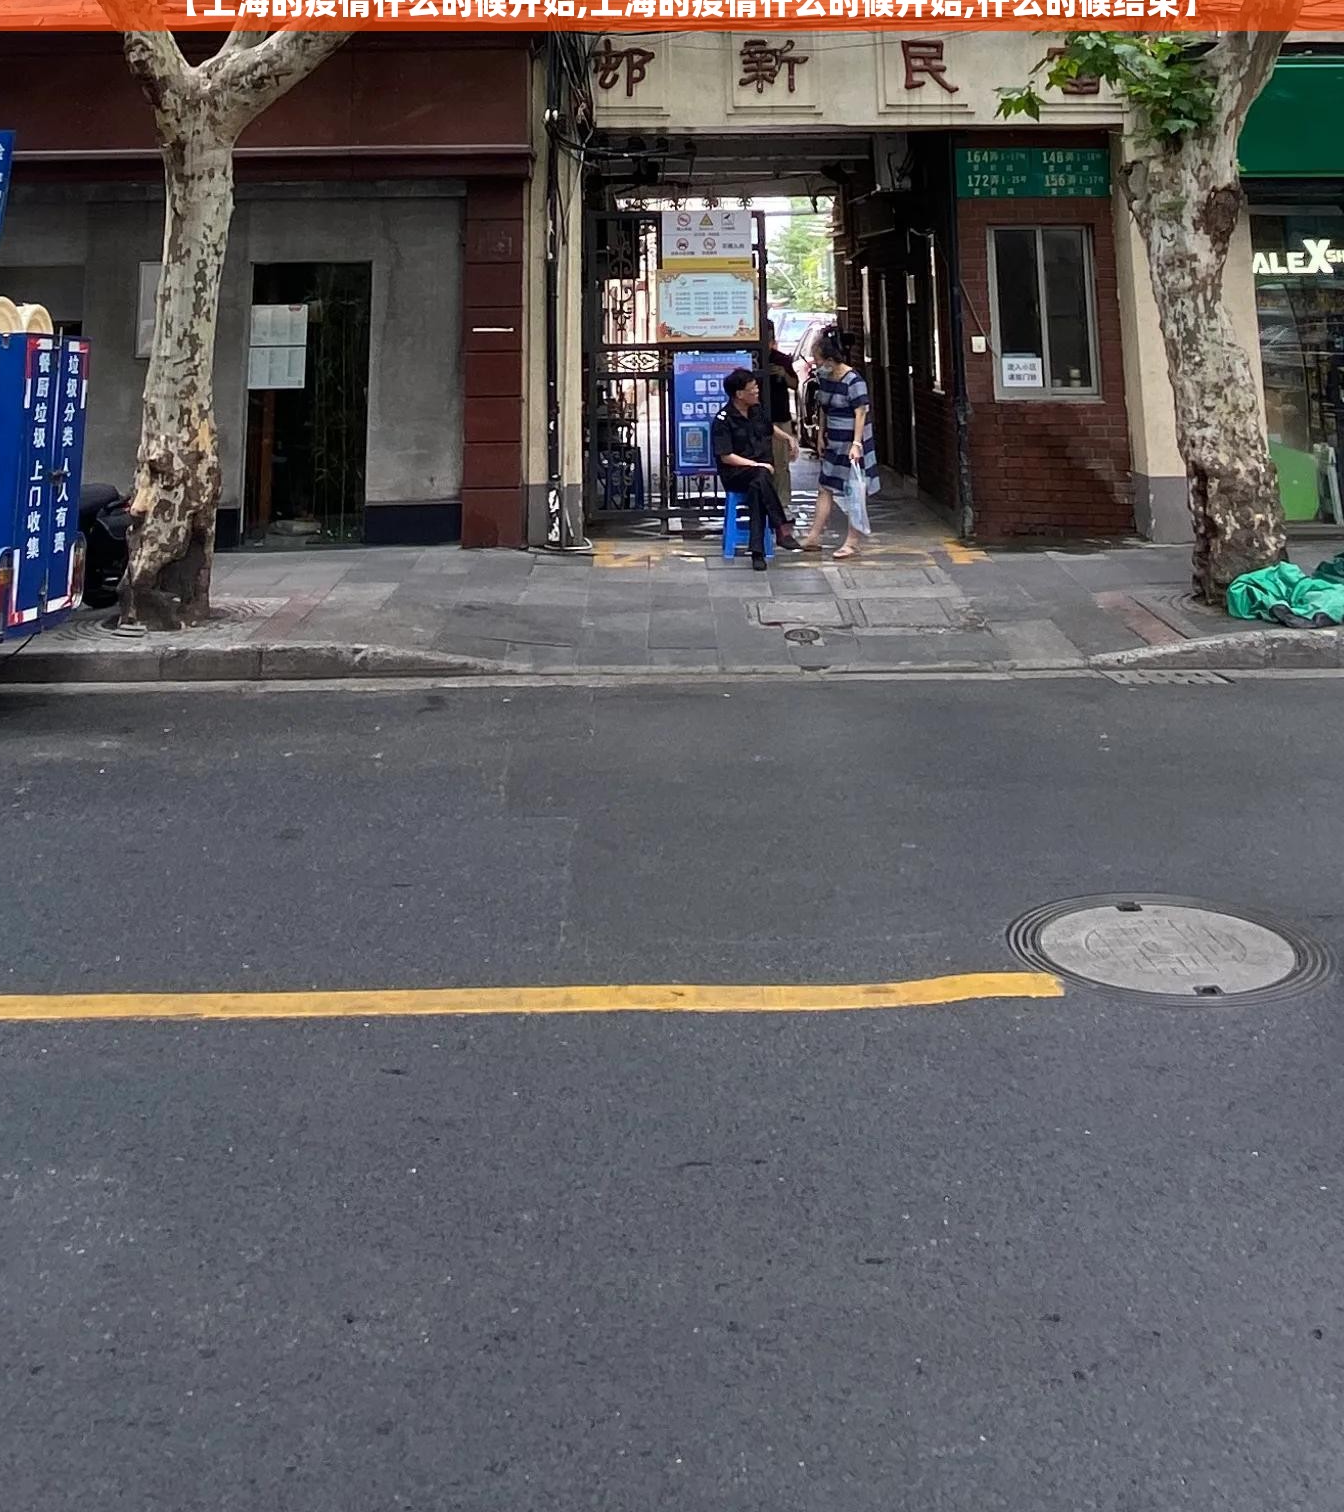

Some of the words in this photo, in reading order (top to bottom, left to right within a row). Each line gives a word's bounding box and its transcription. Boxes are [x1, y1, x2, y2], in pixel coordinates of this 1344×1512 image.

[1252, 239, 1334, 274] ALEX
[32, 352, 51, 448] 餐厨垃圾
[62, 354, 80, 447] 垃圾分类
[26, 459, 43, 560] 上门收集
[52, 457, 72, 554] 人人有责
